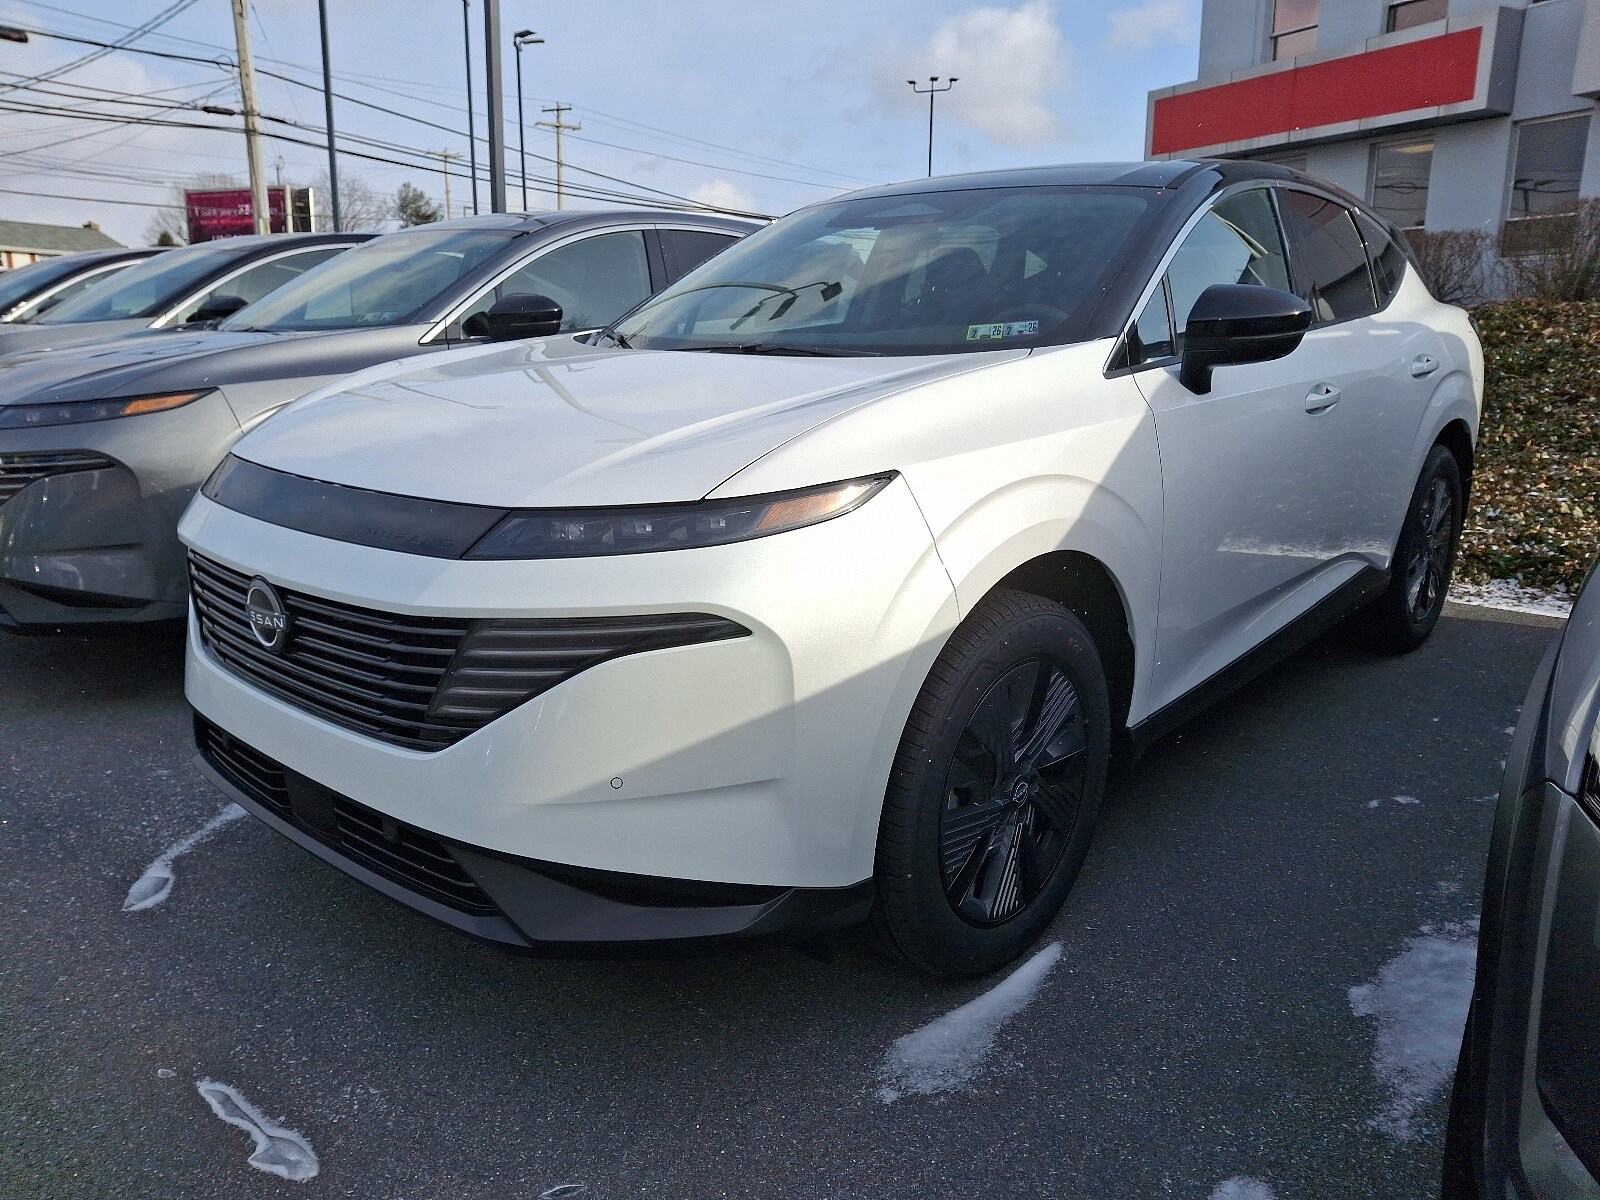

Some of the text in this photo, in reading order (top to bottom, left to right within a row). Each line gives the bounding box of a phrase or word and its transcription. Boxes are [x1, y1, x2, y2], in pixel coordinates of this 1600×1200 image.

[971, 325, 1002, 338] 2 26
[1006, 322, 1038, 336] 2 26
[250, 610, 284, 628] SSAN
